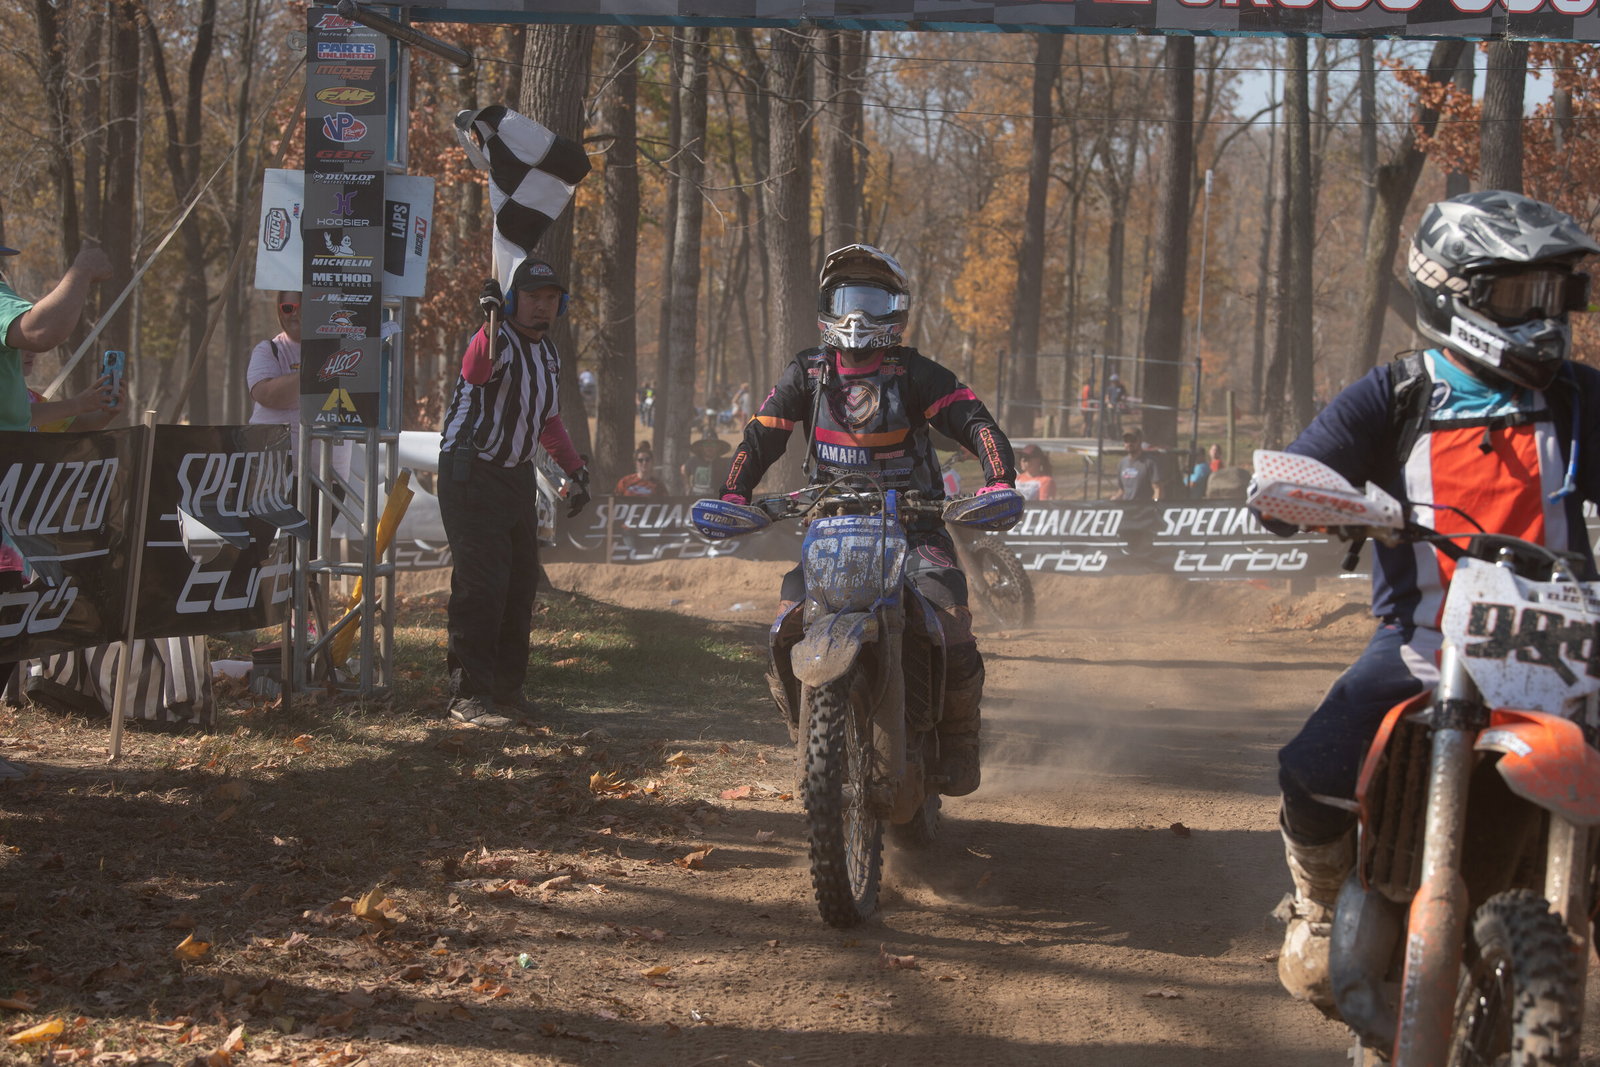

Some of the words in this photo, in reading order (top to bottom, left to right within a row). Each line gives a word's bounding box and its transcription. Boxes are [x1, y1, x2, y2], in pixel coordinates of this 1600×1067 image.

[318, 43, 376, 53] PARTS
[315, 65, 376, 75] MOOSE
[318, 89, 376, 101] FMF
[323, 112, 354, 141] VP
[315, 150, 375, 159] GBC
[325, 173, 376, 181] DUNLOP
[317, 218, 370, 226] HOOSIER
[391, 204, 408, 239] LAPS
[311, 258, 373, 267] MICHELIN
[312, 272, 372, 283] METHOD
[823, 330, 839, 347] 650
[871, 333, 891, 349] 650
[817, 442, 868, 466] YAMAHA
